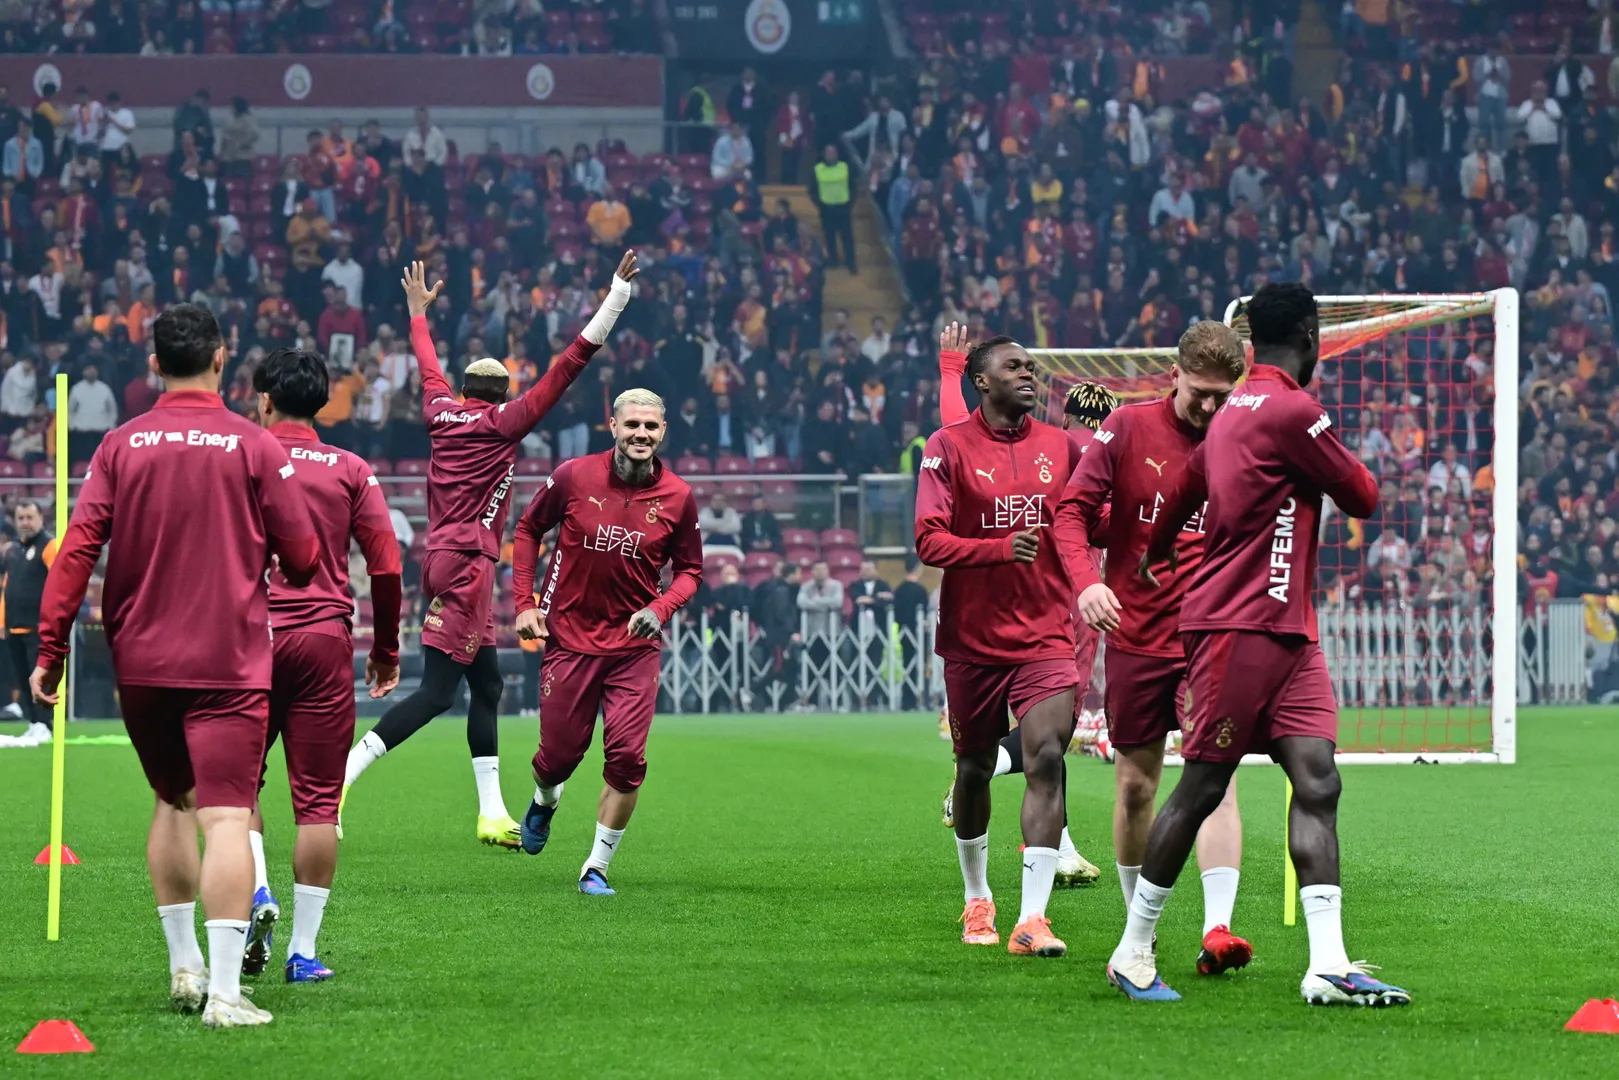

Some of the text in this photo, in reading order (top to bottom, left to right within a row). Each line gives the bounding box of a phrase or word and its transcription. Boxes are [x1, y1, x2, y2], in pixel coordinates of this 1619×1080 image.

[129, 429, 238, 452] CW Enerji
[291, 447, 338, 466] Enerji
[995, 494, 1047, 513] NEXT
[981, 510, 1049, 529] LEVEL
[597, 523, 646, 546] NEXT
[584, 535, 642, 560] LEVEL
[540, 549, 562, 617] LFEMO
[424, 613, 444, 628] ydia
